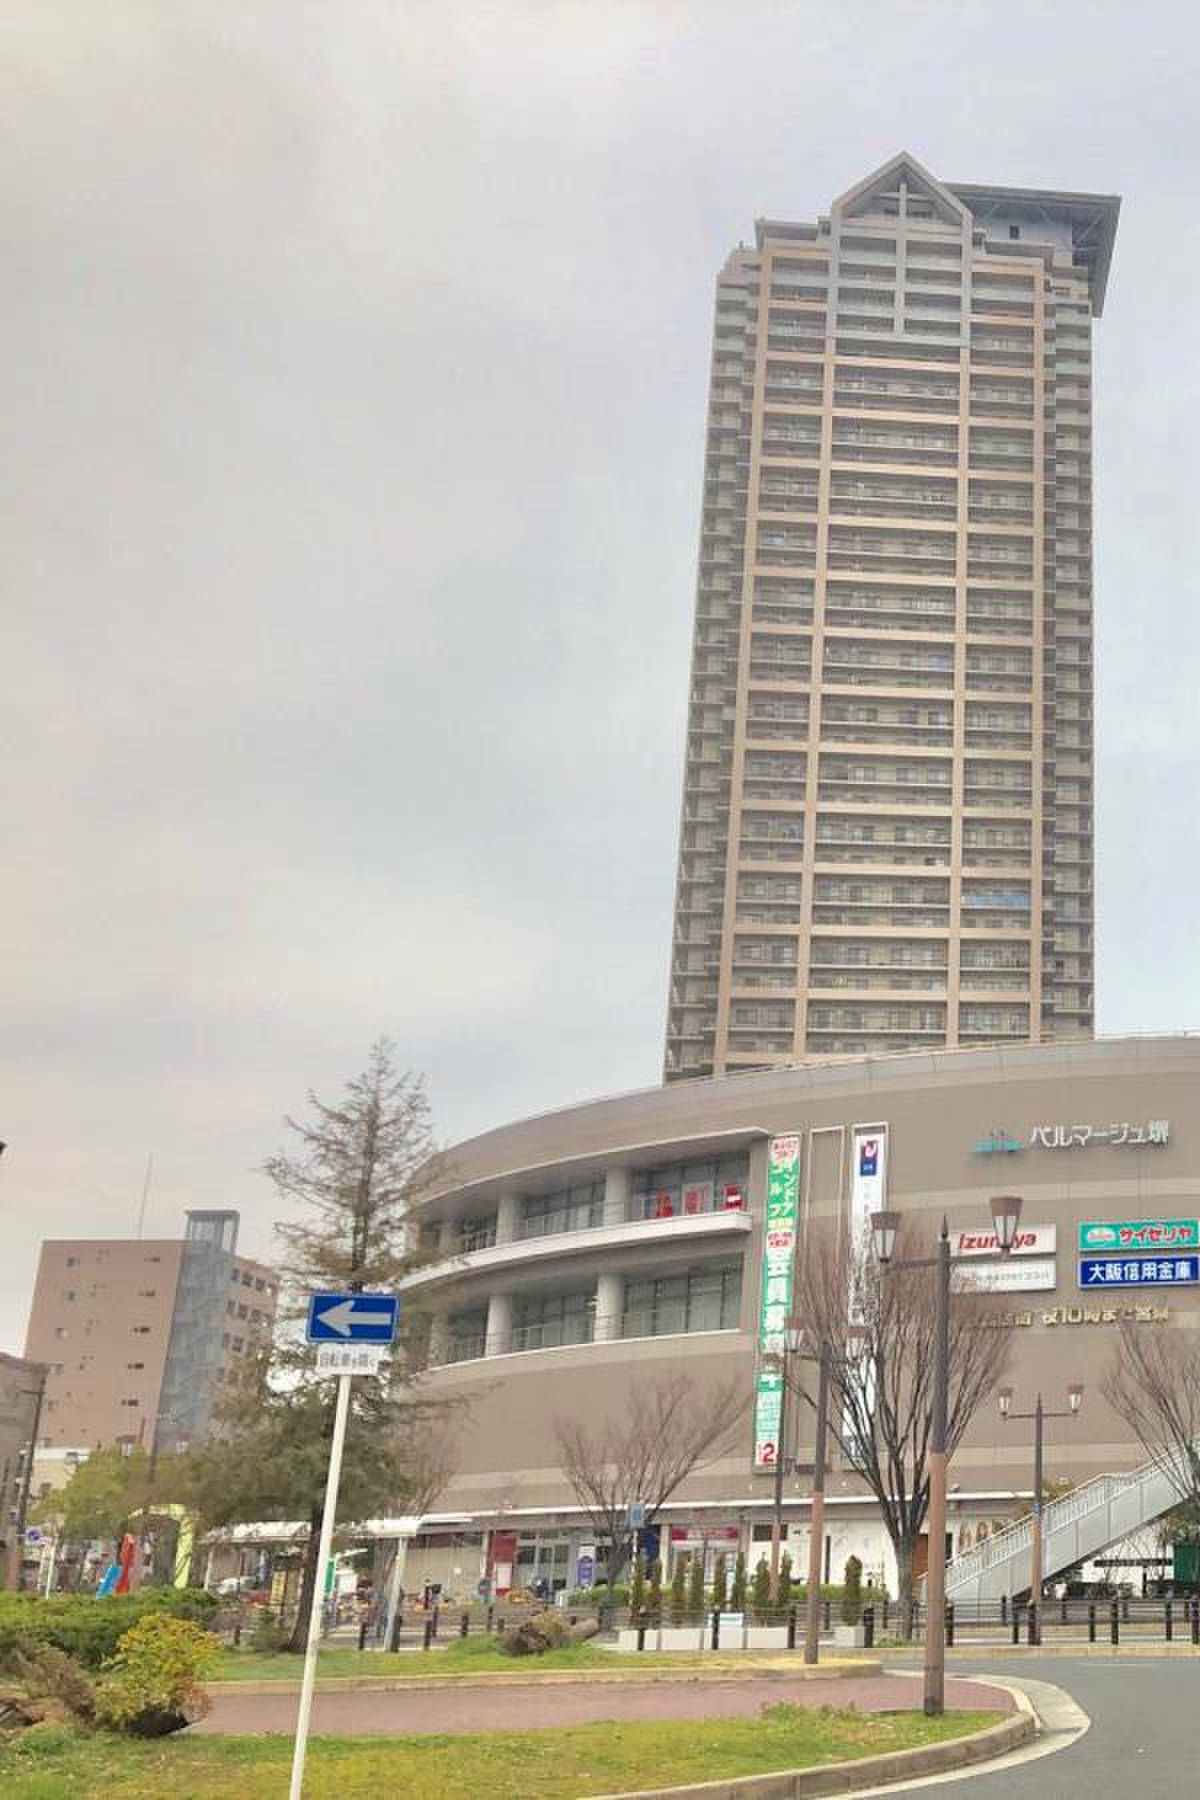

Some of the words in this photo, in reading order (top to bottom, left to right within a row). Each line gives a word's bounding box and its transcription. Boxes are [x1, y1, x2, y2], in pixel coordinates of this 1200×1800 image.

[959, 1233, 1037, 1250] Izuya
[1120, 1225, 1192, 1243] サイゼリヤ
[1088, 1261, 1191, 1282] 大阪信用金庫
[762, 1442, 776, 1463] 2
